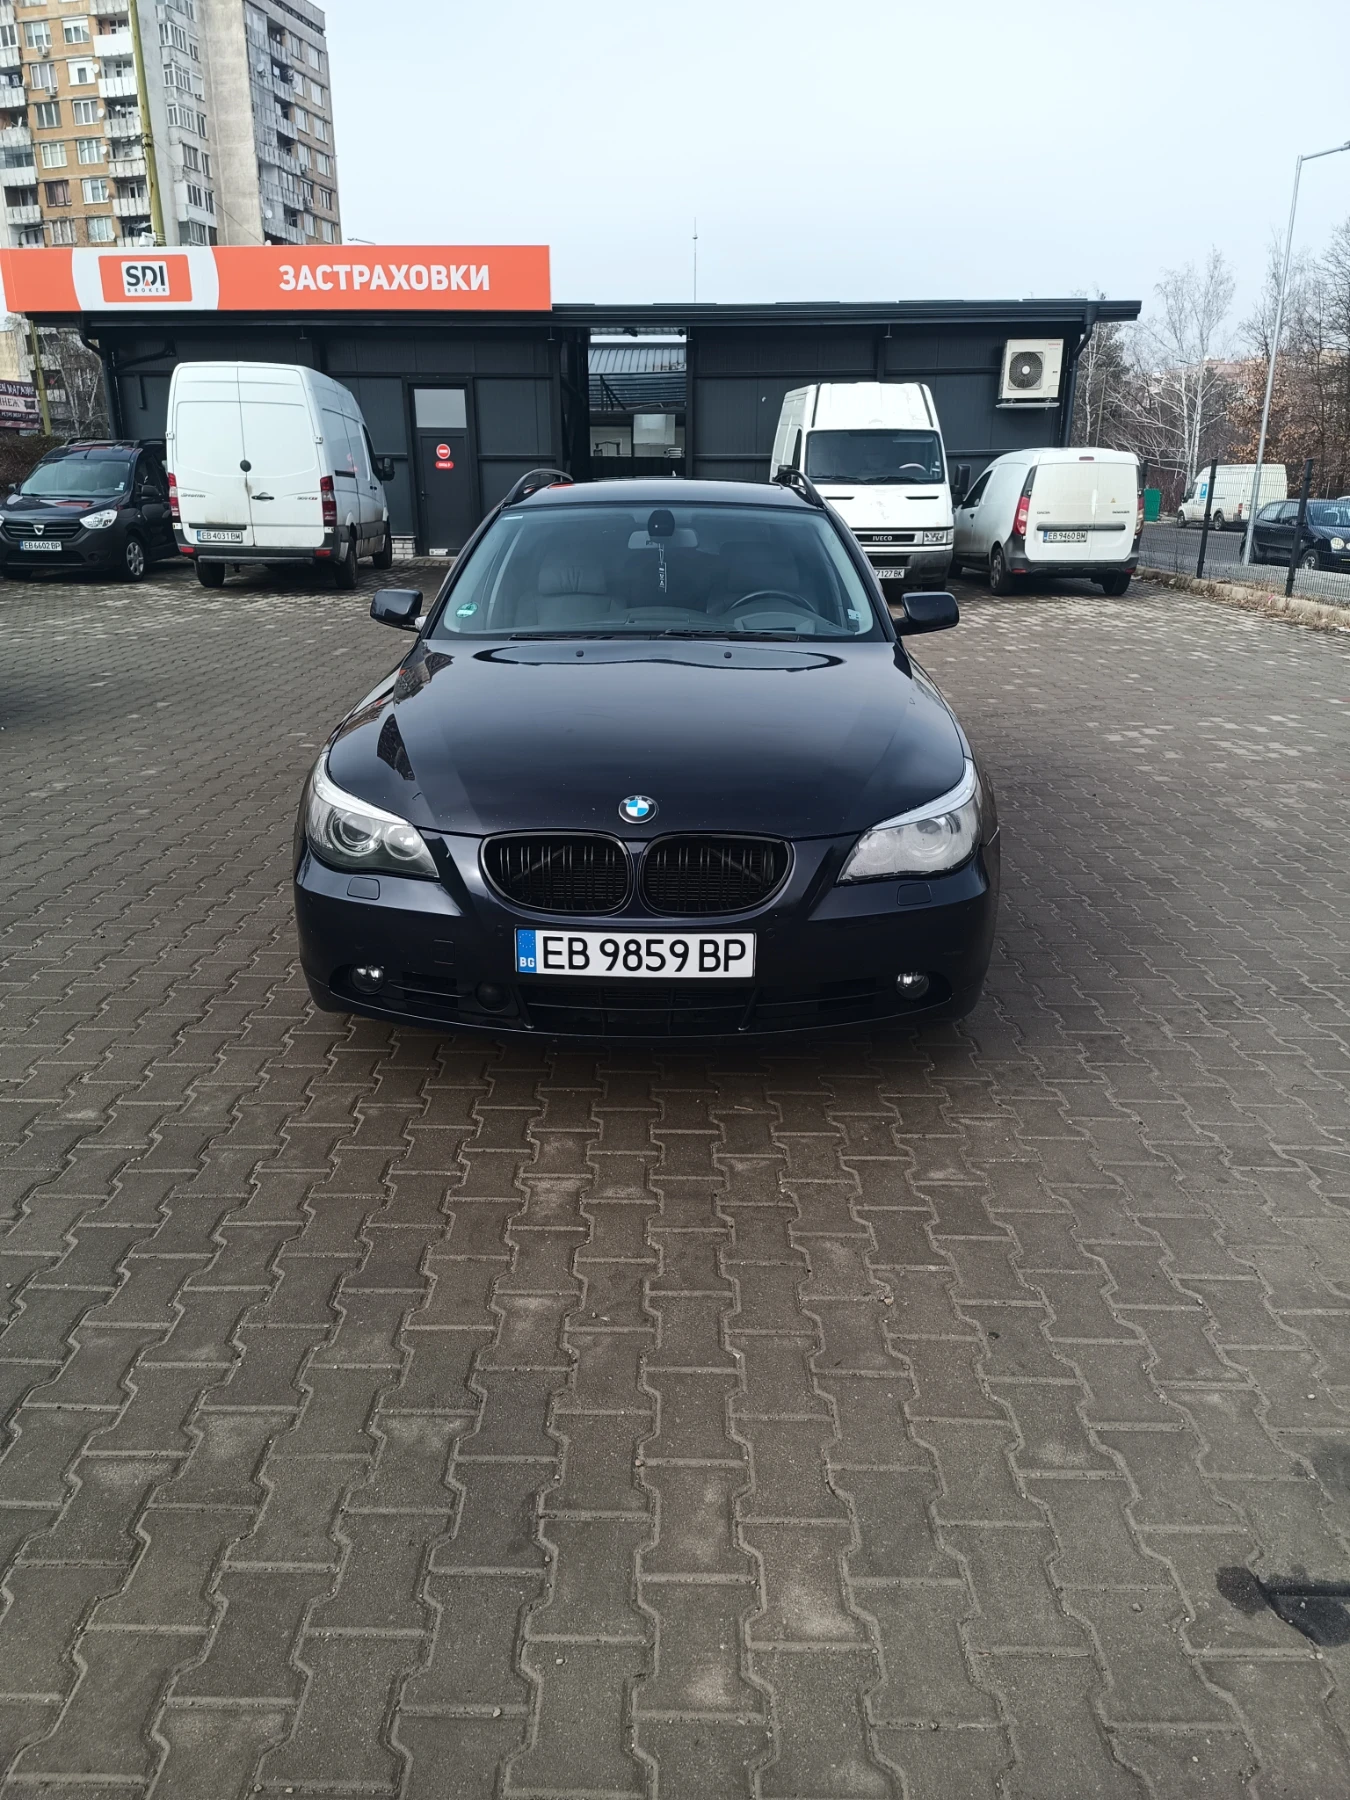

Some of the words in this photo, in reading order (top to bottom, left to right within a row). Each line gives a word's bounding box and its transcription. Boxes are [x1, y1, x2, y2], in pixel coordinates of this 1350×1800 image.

[125, 265, 166, 287] SDI
[278, 264, 490, 291] ЗАСТРАХОВКИ
[201, 532, 212, 540] EB
[212, 532, 230, 541] 4031
[231, 533, 241, 541] BM
[1048, 532, 1058, 540] EB
[1059, 532, 1076, 540] 9460
[1076, 532, 1086, 540] BM
[519, 956, 535, 968] BG
[542, 935, 590, 970] EB
[599, 938, 690, 973] 9859
[698, 938, 747, 973] BP
